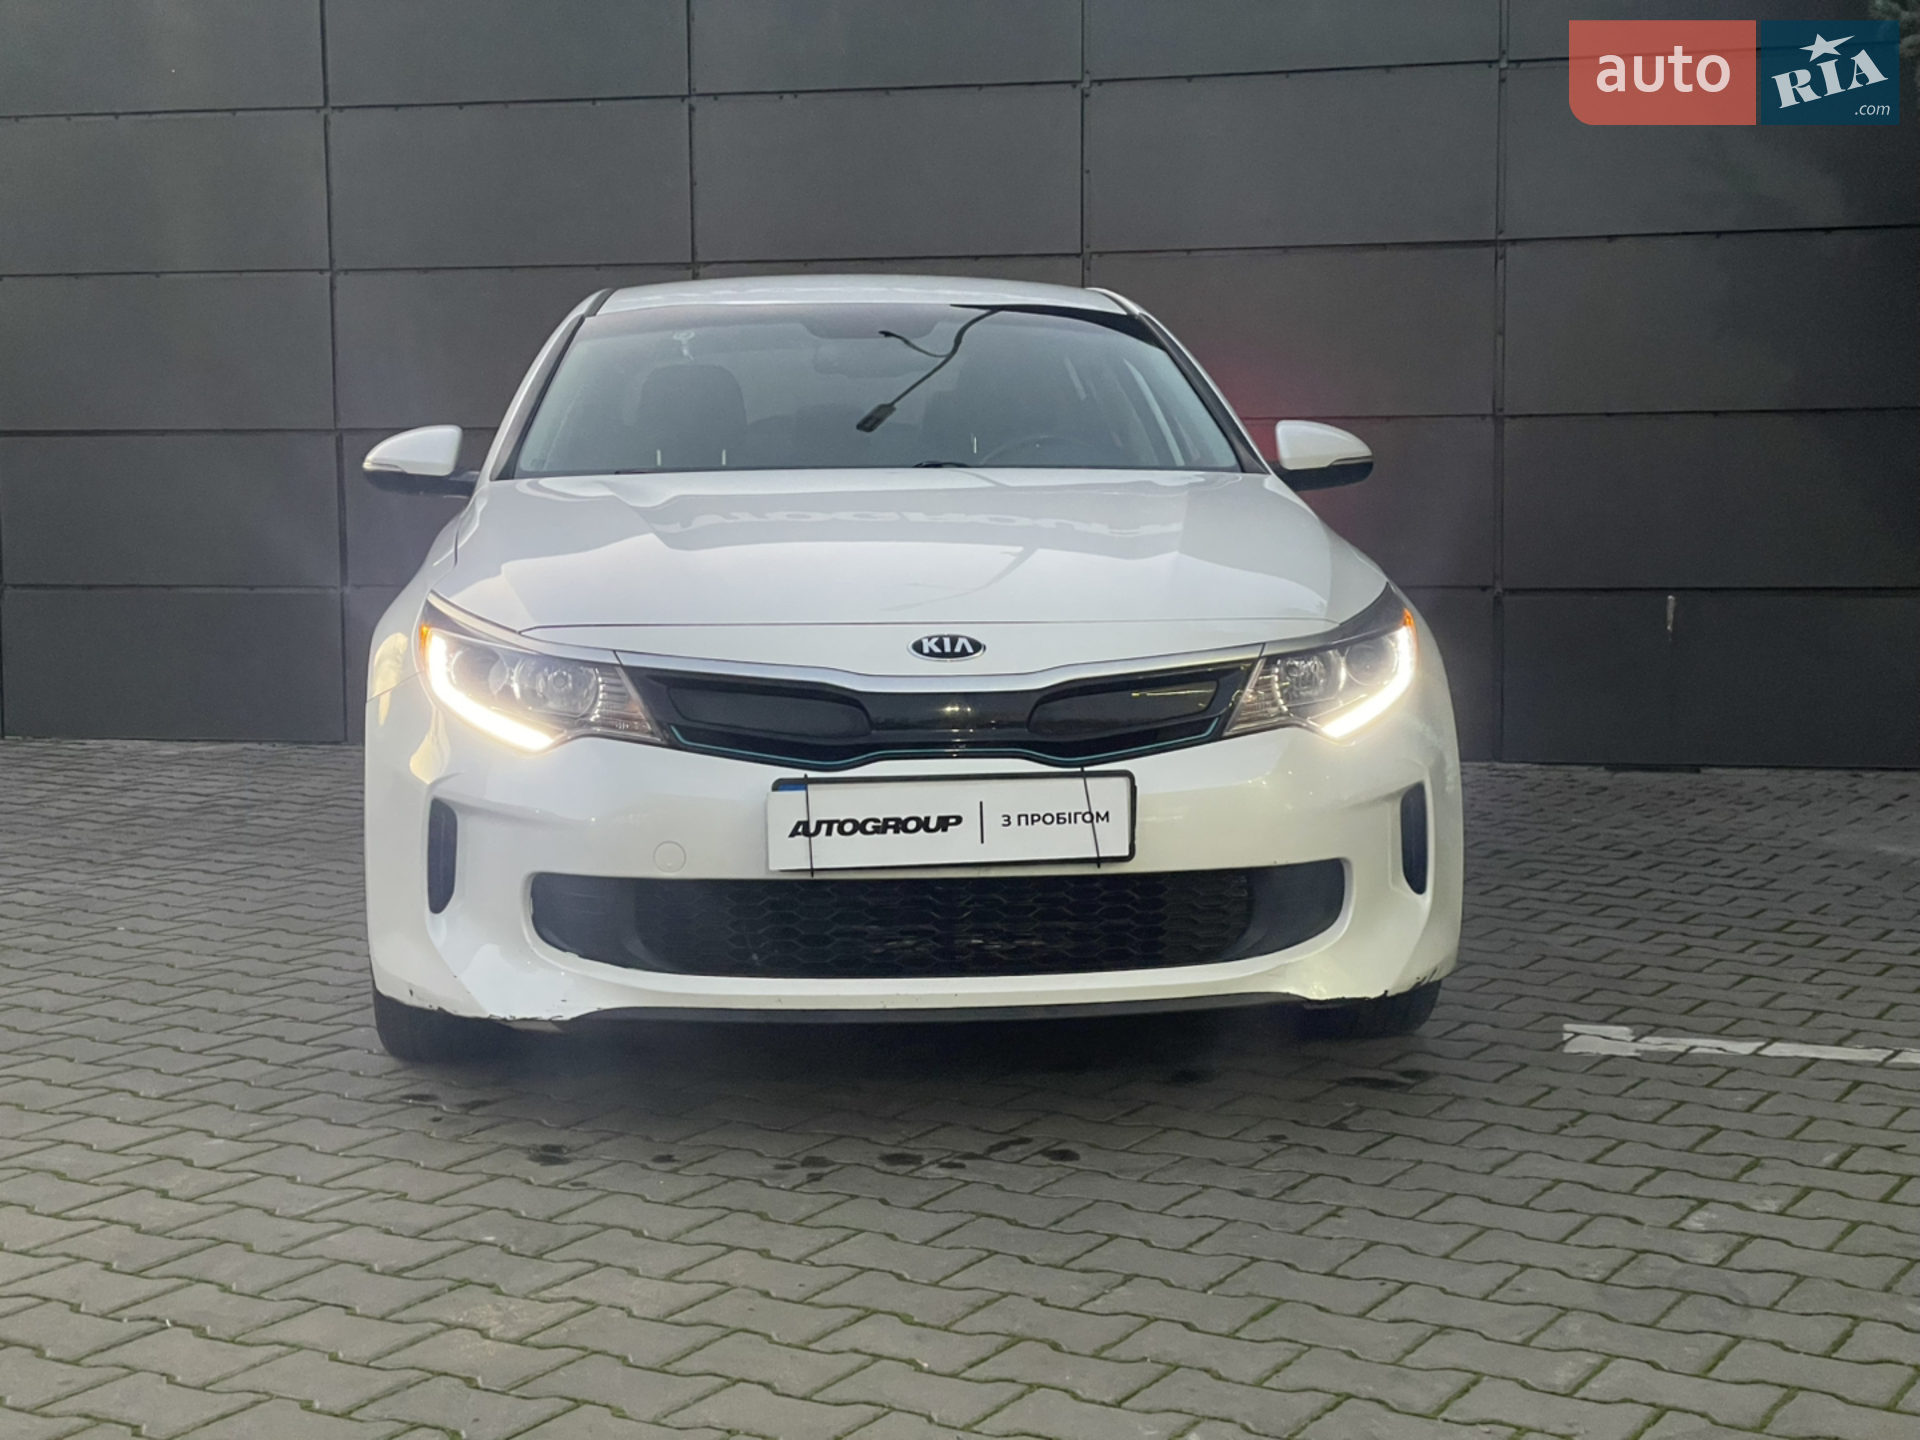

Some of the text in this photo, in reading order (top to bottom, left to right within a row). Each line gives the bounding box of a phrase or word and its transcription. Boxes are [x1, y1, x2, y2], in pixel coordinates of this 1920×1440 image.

[921, 636, 974, 654] KIA
[788, 815, 963, 838] AUTOGROUP
[1017, 810, 1110, 827] ПРОБІГОМ
